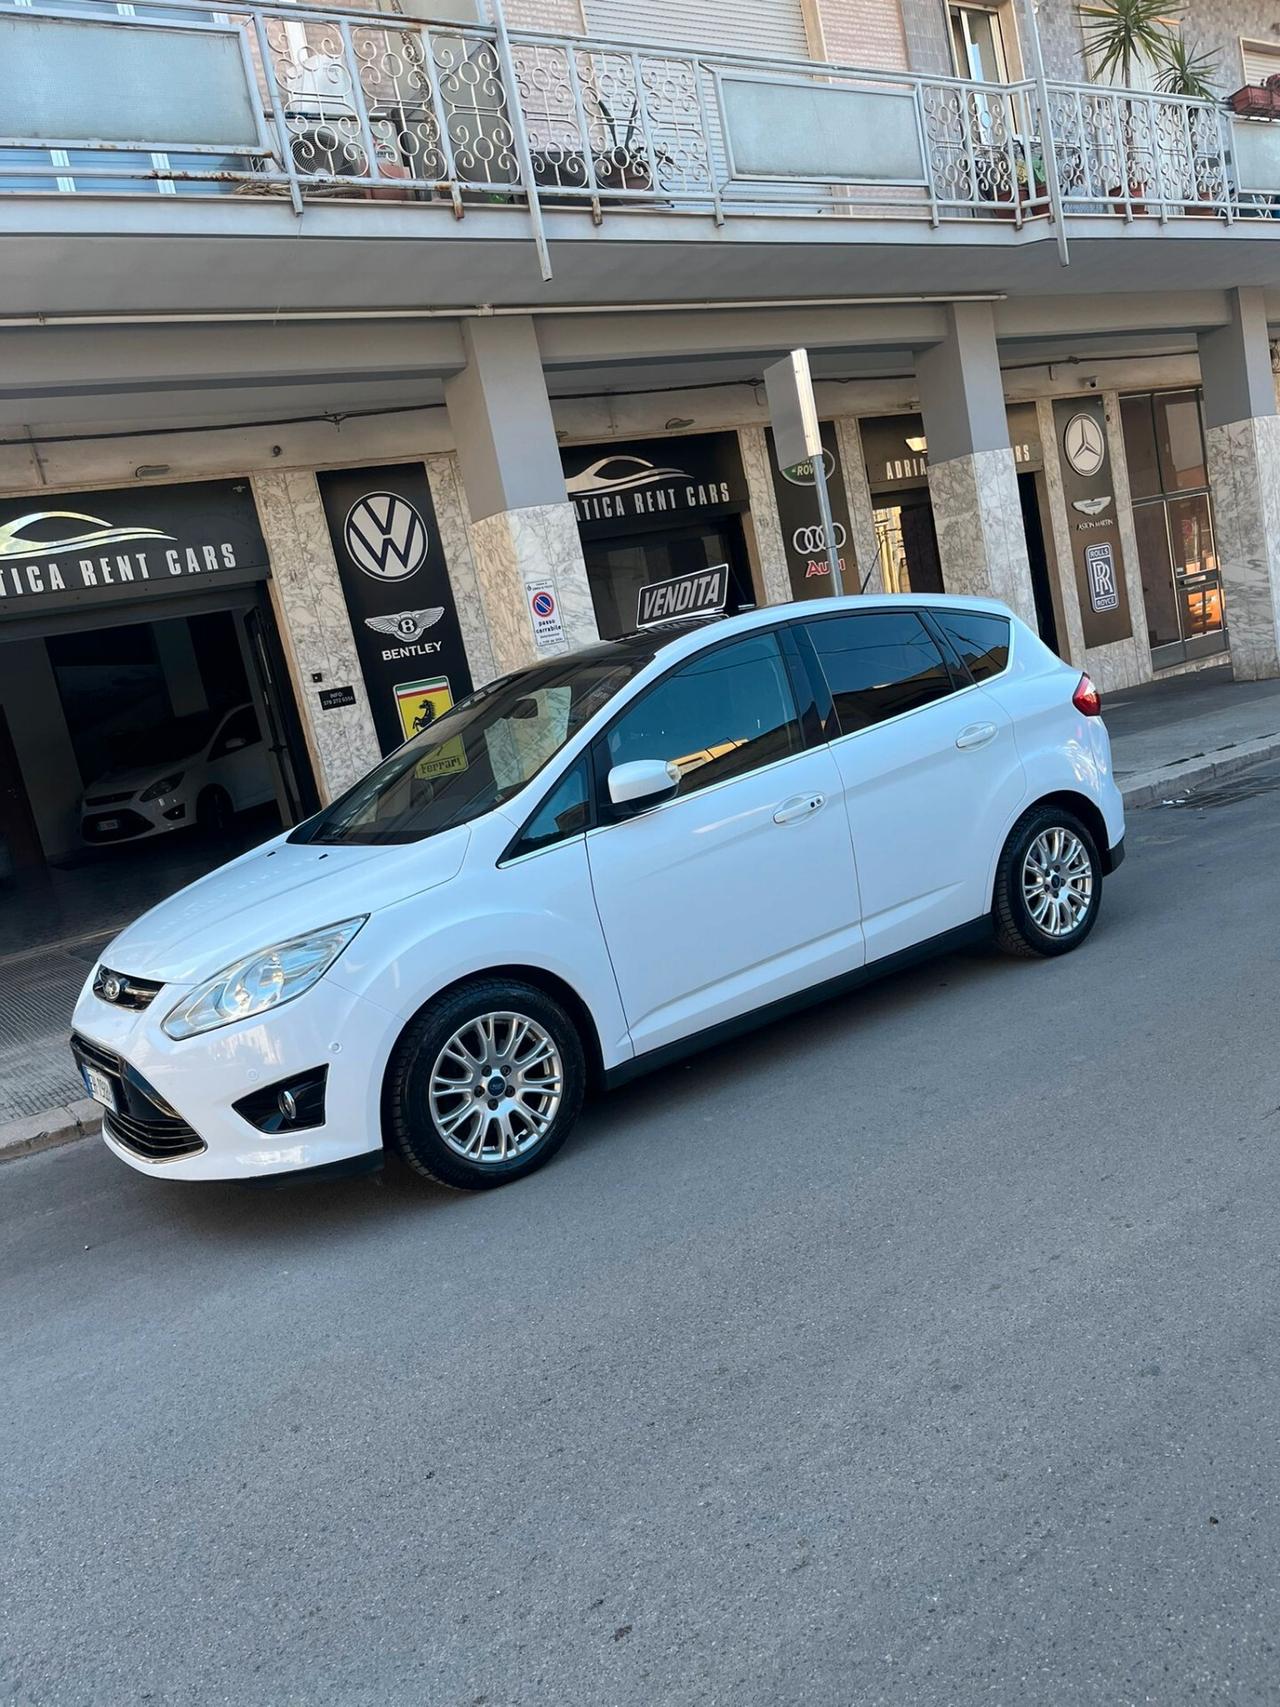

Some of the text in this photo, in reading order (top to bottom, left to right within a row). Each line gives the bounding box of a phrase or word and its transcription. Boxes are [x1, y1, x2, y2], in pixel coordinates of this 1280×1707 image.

[1015, 444, 1030, 462] RS
[634, 487, 676, 515] RENT
[686, 482, 730, 508] CARS
[1089, 547, 1109, 558] ROLLS
[79, 552, 150, 587] RENT
[165, 542, 236, 575] CARS
[805, 559, 846, 578] Aui
[643, 572, 721, 620] VENDITA
[1095, 596, 1115, 607] ROYCE
[535, 625, 562, 634] carrabile
[381, 641, 442, 661] BENTLEY
[420, 755, 461, 774] Ferrari
